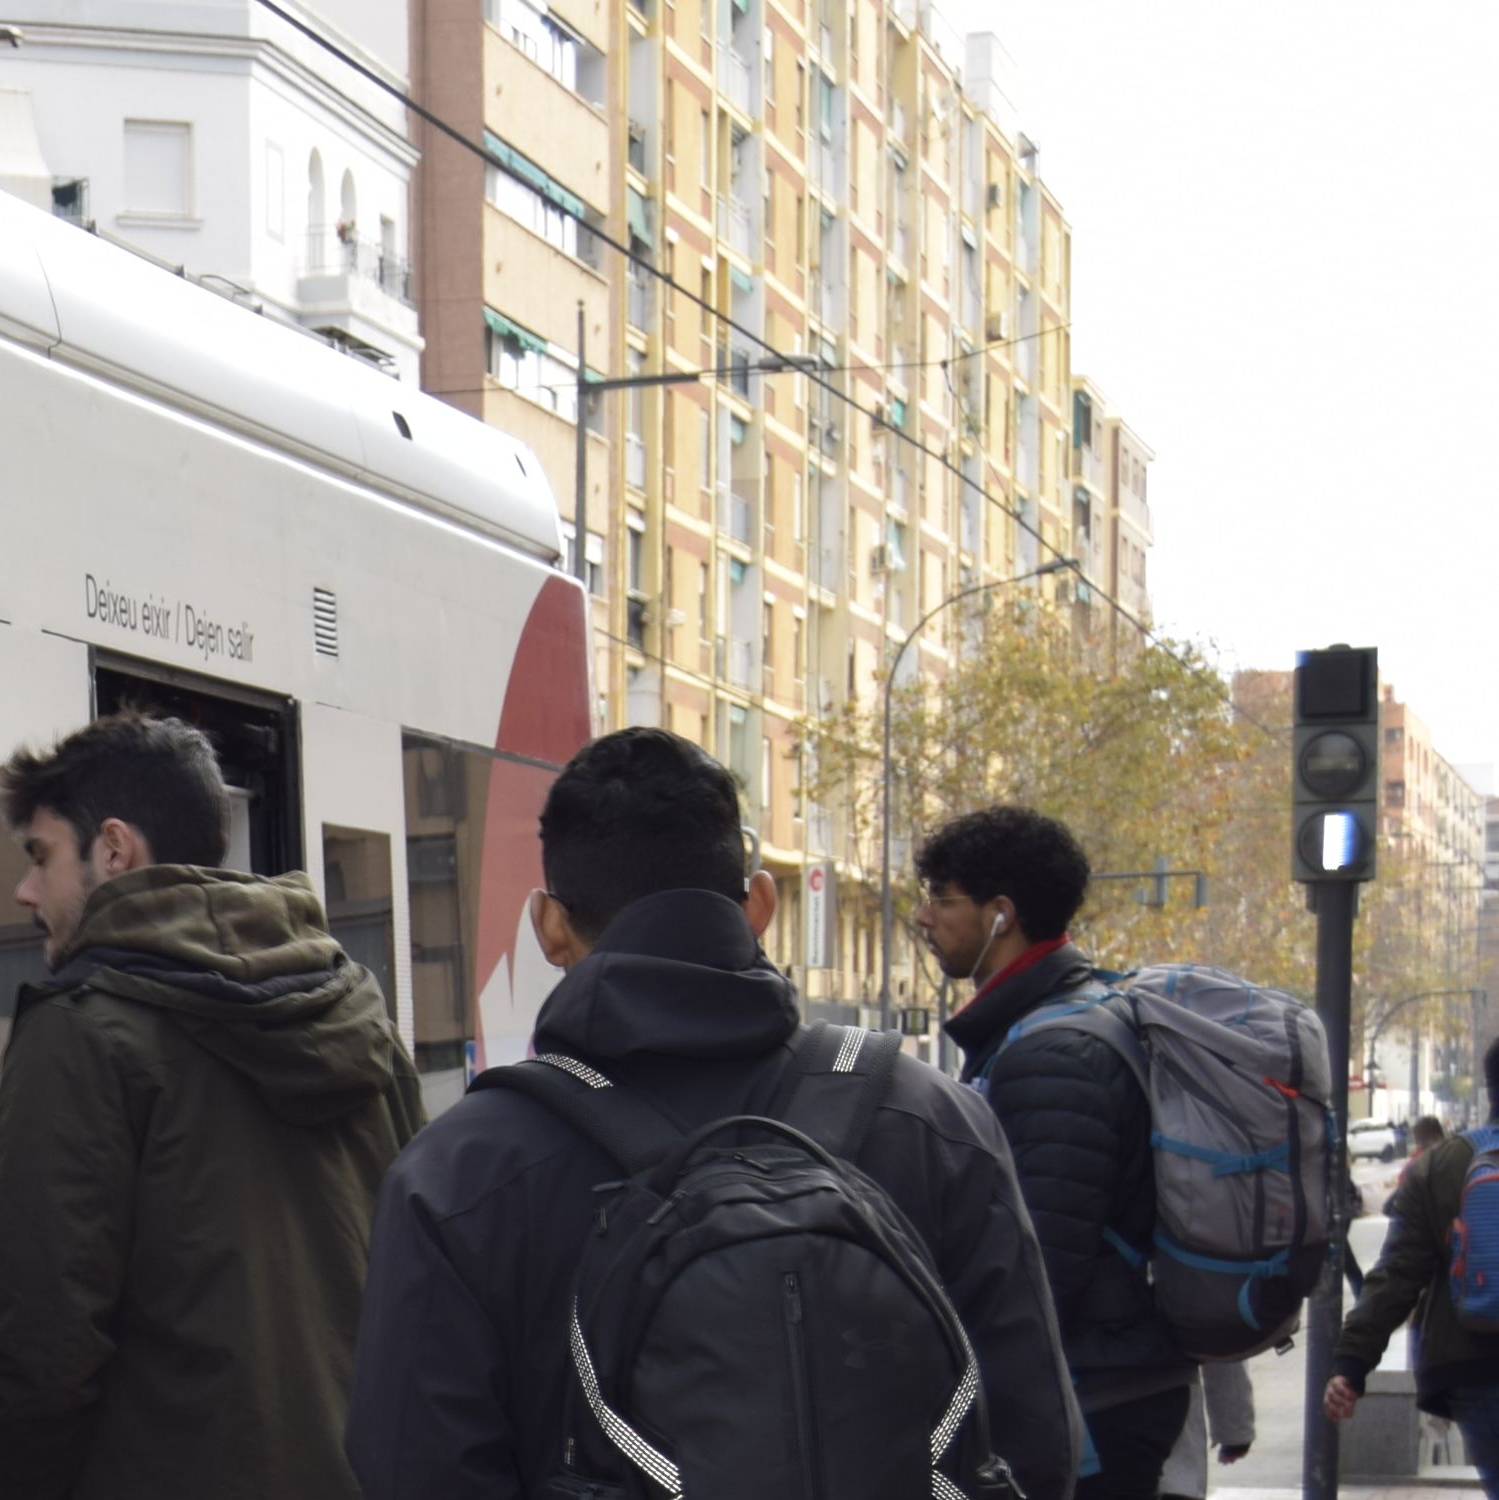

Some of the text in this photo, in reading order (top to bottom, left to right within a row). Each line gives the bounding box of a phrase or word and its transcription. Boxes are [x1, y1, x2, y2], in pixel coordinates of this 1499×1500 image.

[85, 573, 137, 630] Deixeu
[142, 593, 171, 640] eixir
[184, 602, 225, 662] Dejen
[228, 620, 254, 663] salir
